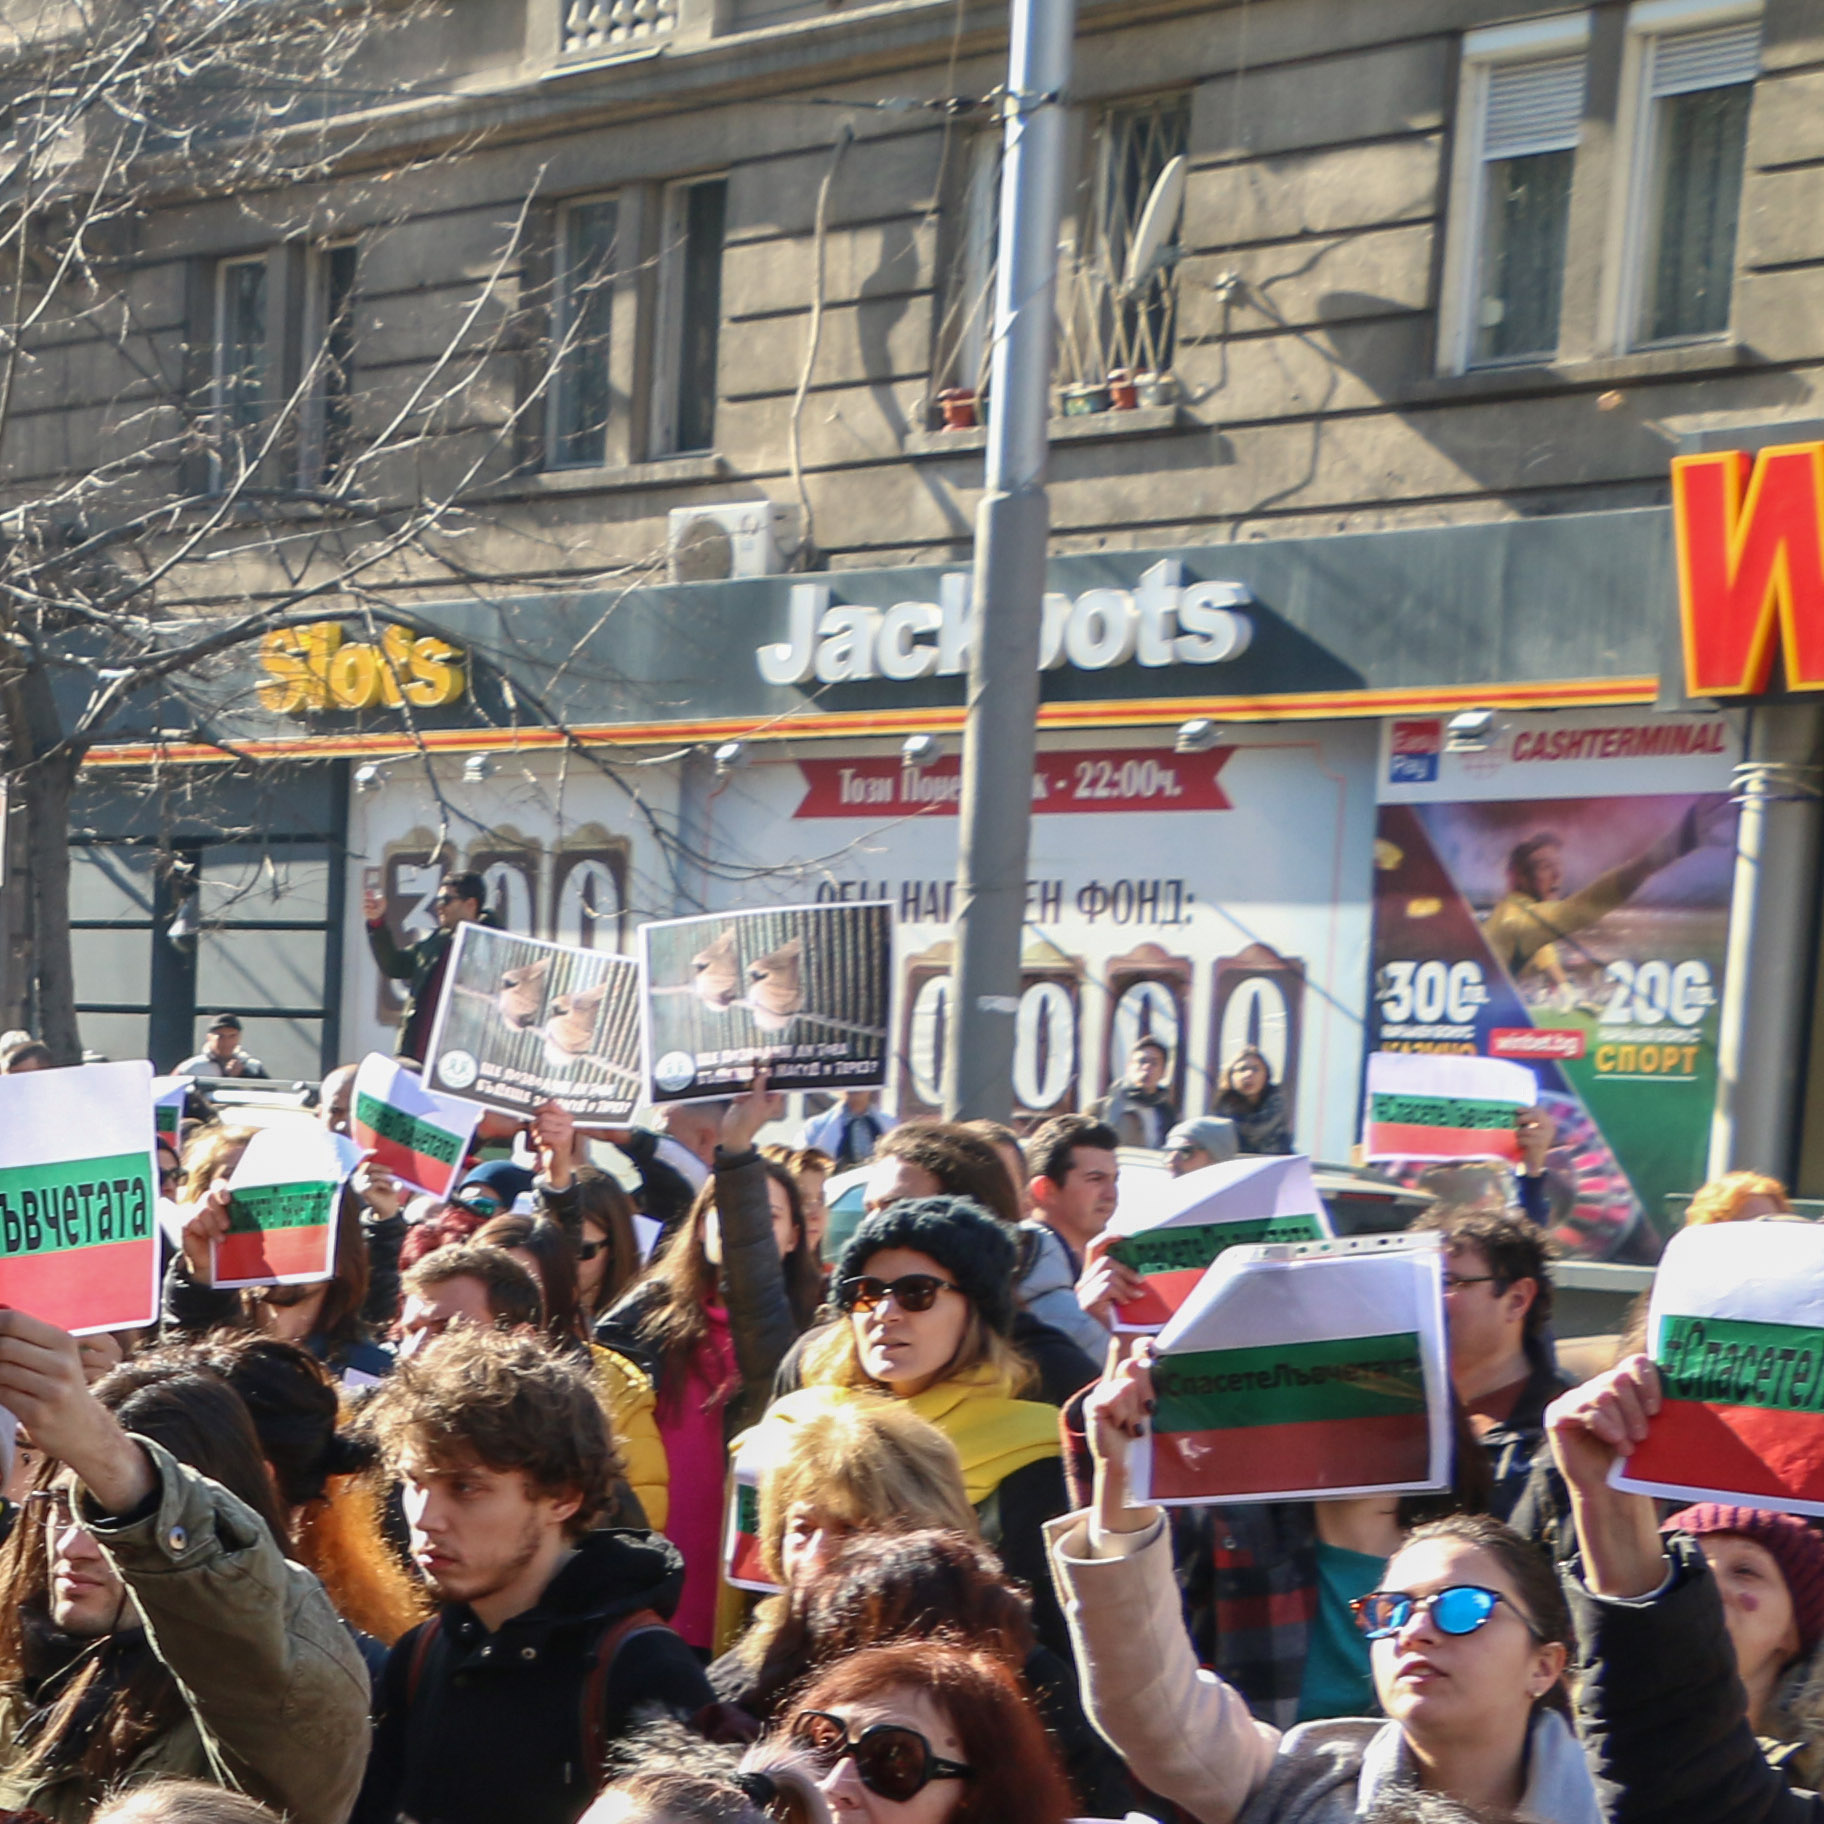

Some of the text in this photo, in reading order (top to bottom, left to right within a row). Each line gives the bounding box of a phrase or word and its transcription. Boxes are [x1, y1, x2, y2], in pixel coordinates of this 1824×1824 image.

[258, 620, 466, 714] Slots
[1512, 723, 1727, 762] CASHTERMINAL
[837, 767, 893, 804] Този
[1076, 879, 1194, 926] ФОНД:
[1594, 1044, 1699, 1075] СПОРТ
